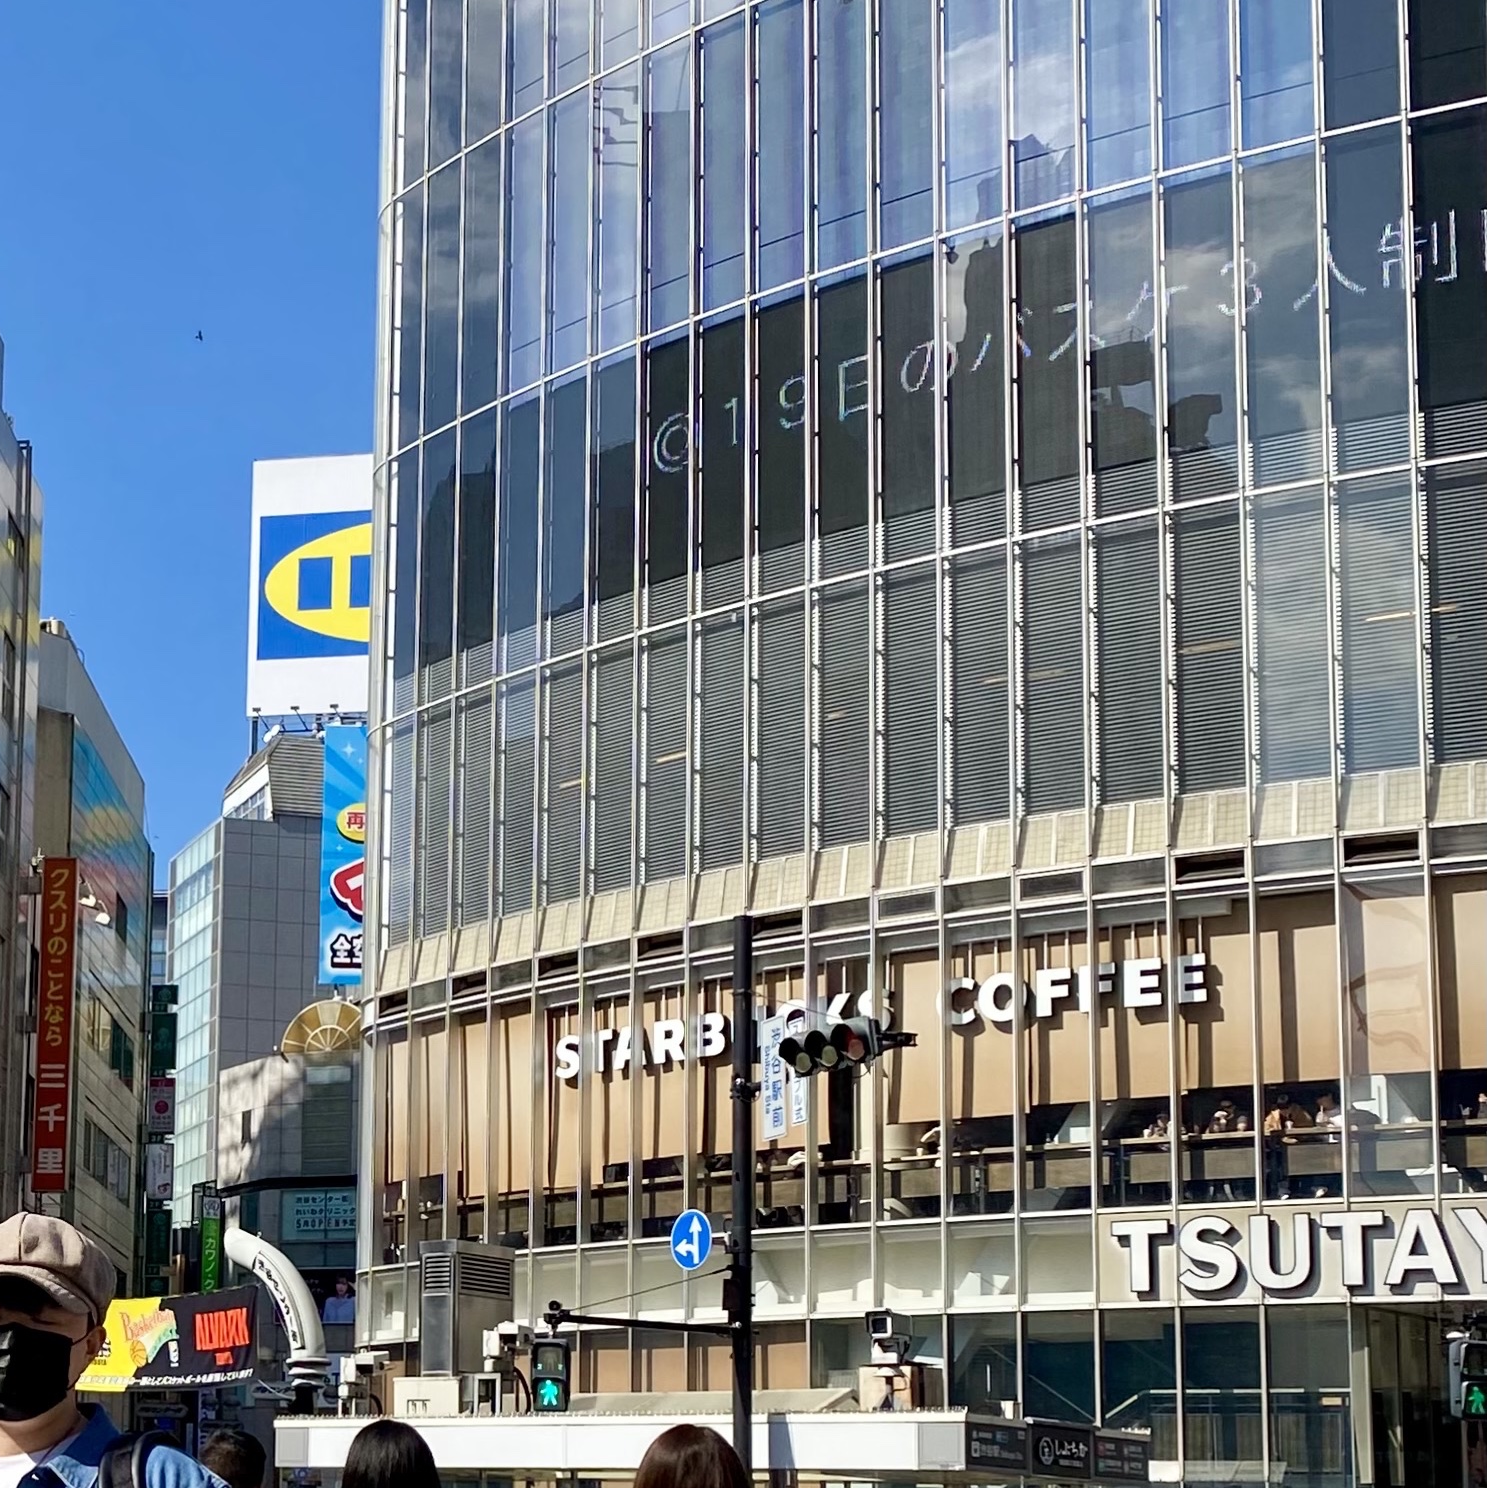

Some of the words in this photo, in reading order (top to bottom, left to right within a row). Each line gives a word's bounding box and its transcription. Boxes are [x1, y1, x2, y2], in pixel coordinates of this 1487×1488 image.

[653, 207, 1487, 473] @19日のバスケ3人制
[346, 811, 365, 831] 再
[45, 867, 69, 1047] クスリのことなら
[555, 987, 893, 1081] STARBKS
[935, 952, 1208, 1027] COFFEE
[35, 1063, 66, 1175] 三千里
[195, 1307, 250, 1351] ALVARK
